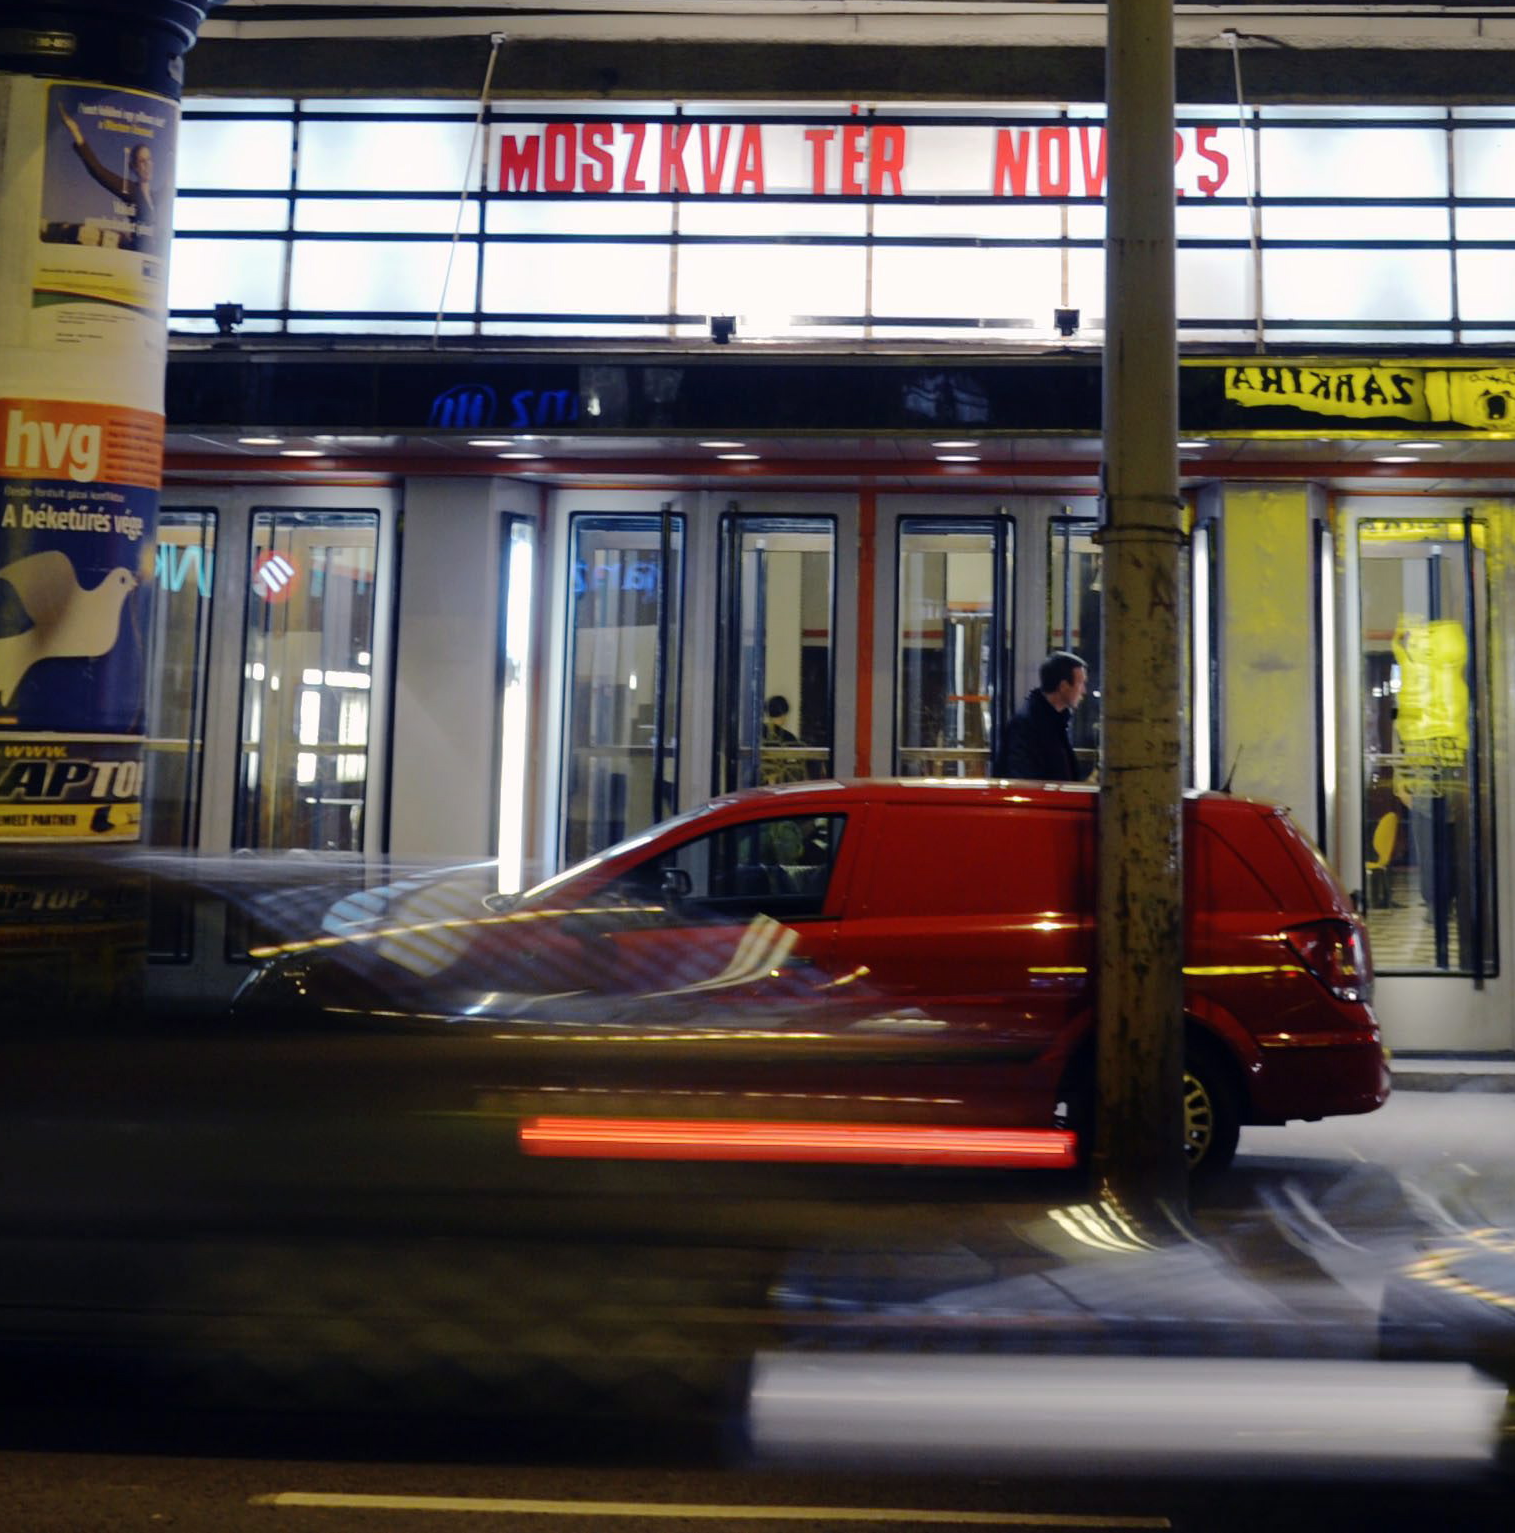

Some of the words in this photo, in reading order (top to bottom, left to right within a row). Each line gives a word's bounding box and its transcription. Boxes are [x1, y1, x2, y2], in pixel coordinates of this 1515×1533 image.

[499, 122, 766, 195] MOSZKVA
[803, 104, 906, 196] TÉR
[4, 408, 102, 483] hvg
[1, 503, 17, 528] A
[21, 502, 112, 532] béketűrés
[114, 508, 144, 540] vége
[30, 813, 77, 827] PARTNER
